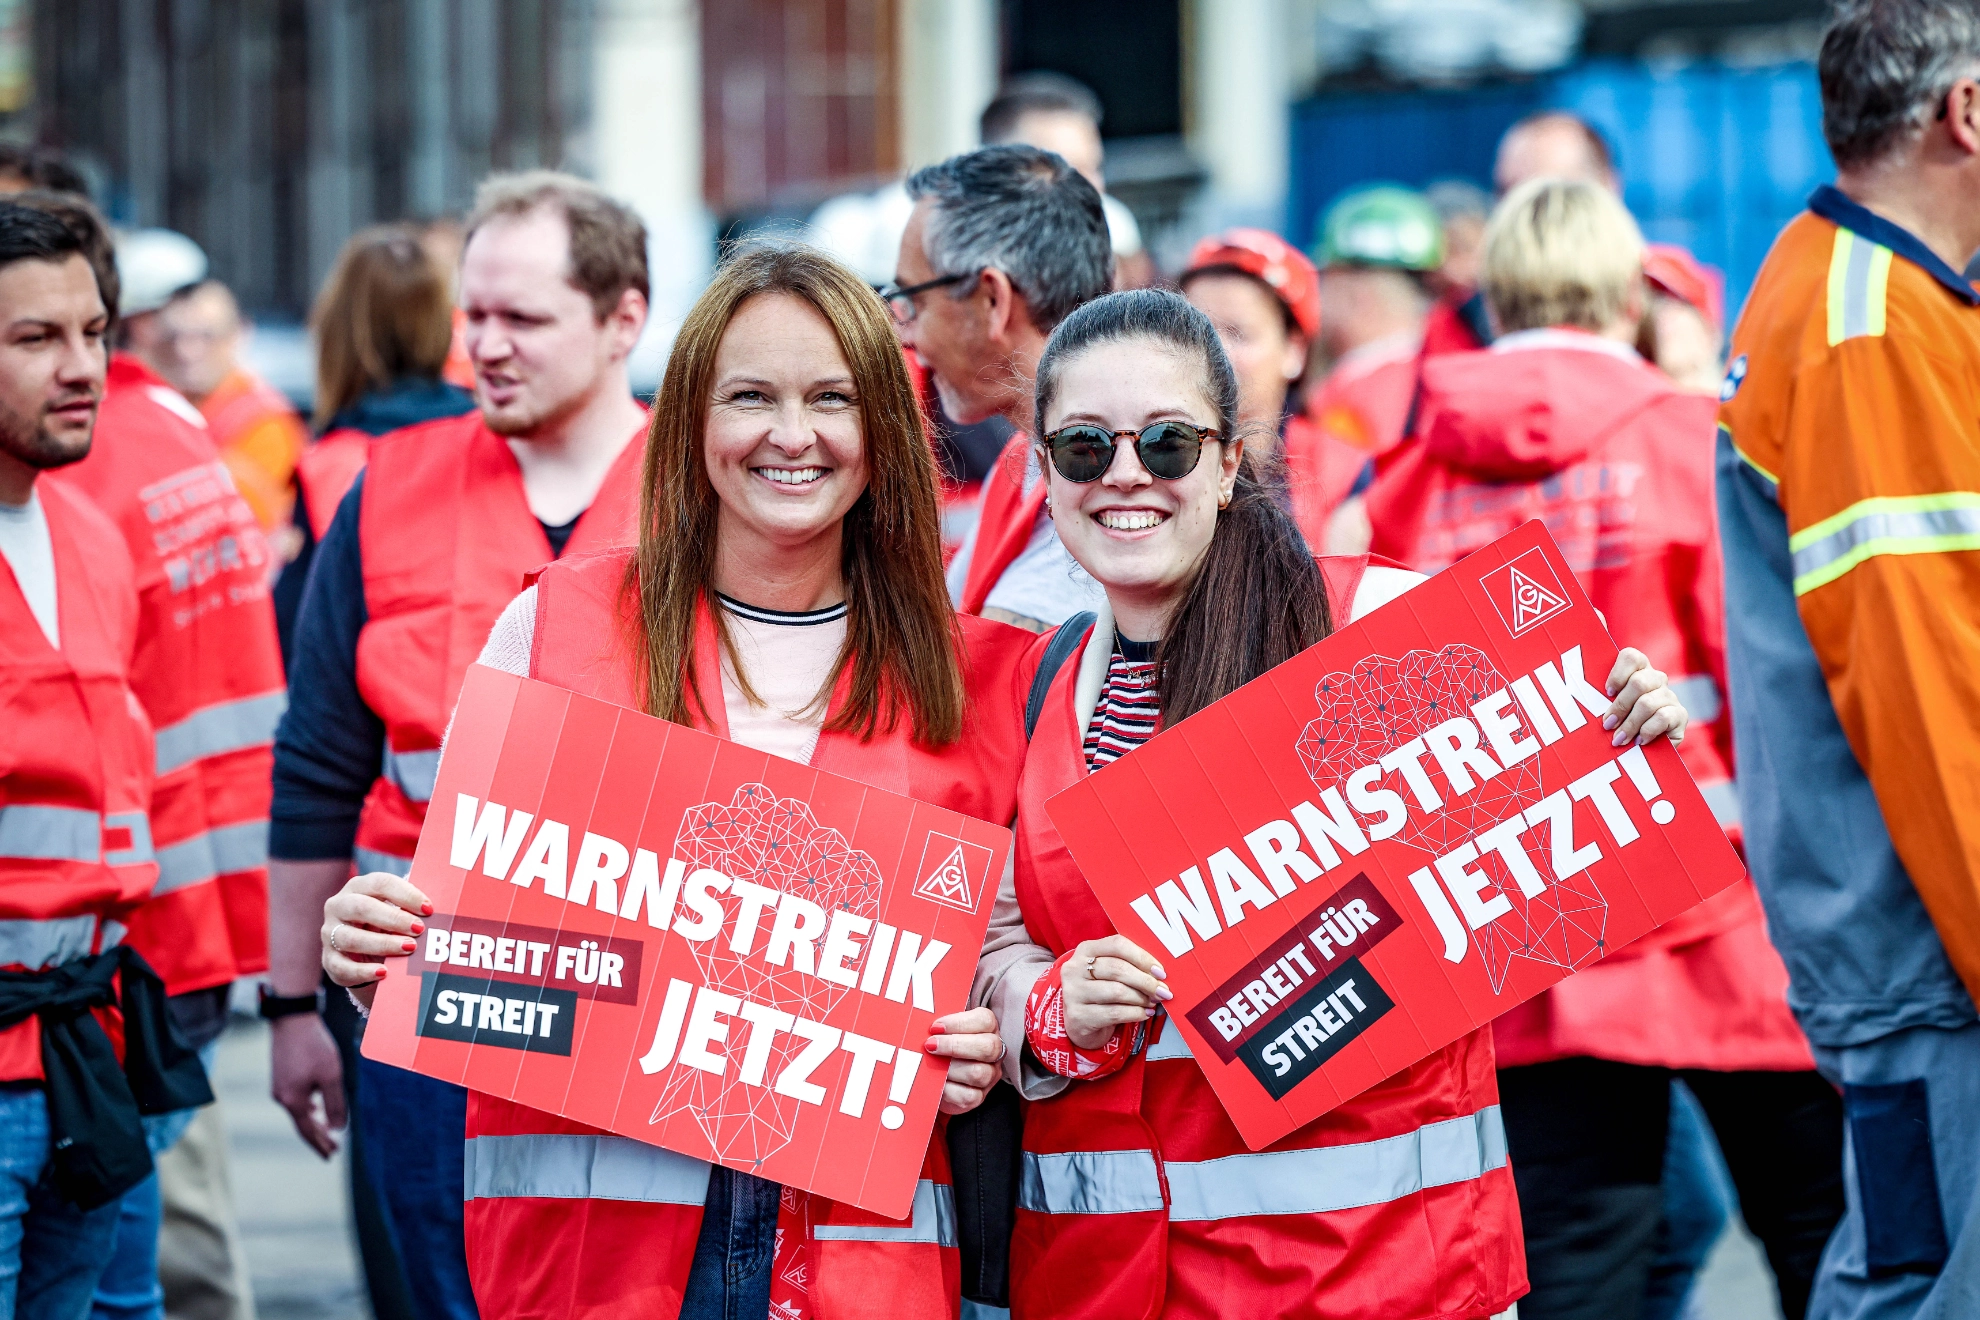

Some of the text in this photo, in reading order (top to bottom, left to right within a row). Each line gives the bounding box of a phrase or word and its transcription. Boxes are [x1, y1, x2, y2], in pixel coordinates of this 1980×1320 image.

[1129, 644, 1612, 959] WARNSTREIK
[1408, 744, 1676, 965] JETZT!
[424, 928, 625, 988] BEREIT FÜR
[449, 792, 952, 1014] WARNSTREIK
[1207, 897, 1381, 1043] BEREIT FÜR
[433, 988, 559, 1038] STREIT
[638, 977, 923, 1131] JETZT!
[1261, 978, 1368, 1078] STREIT
